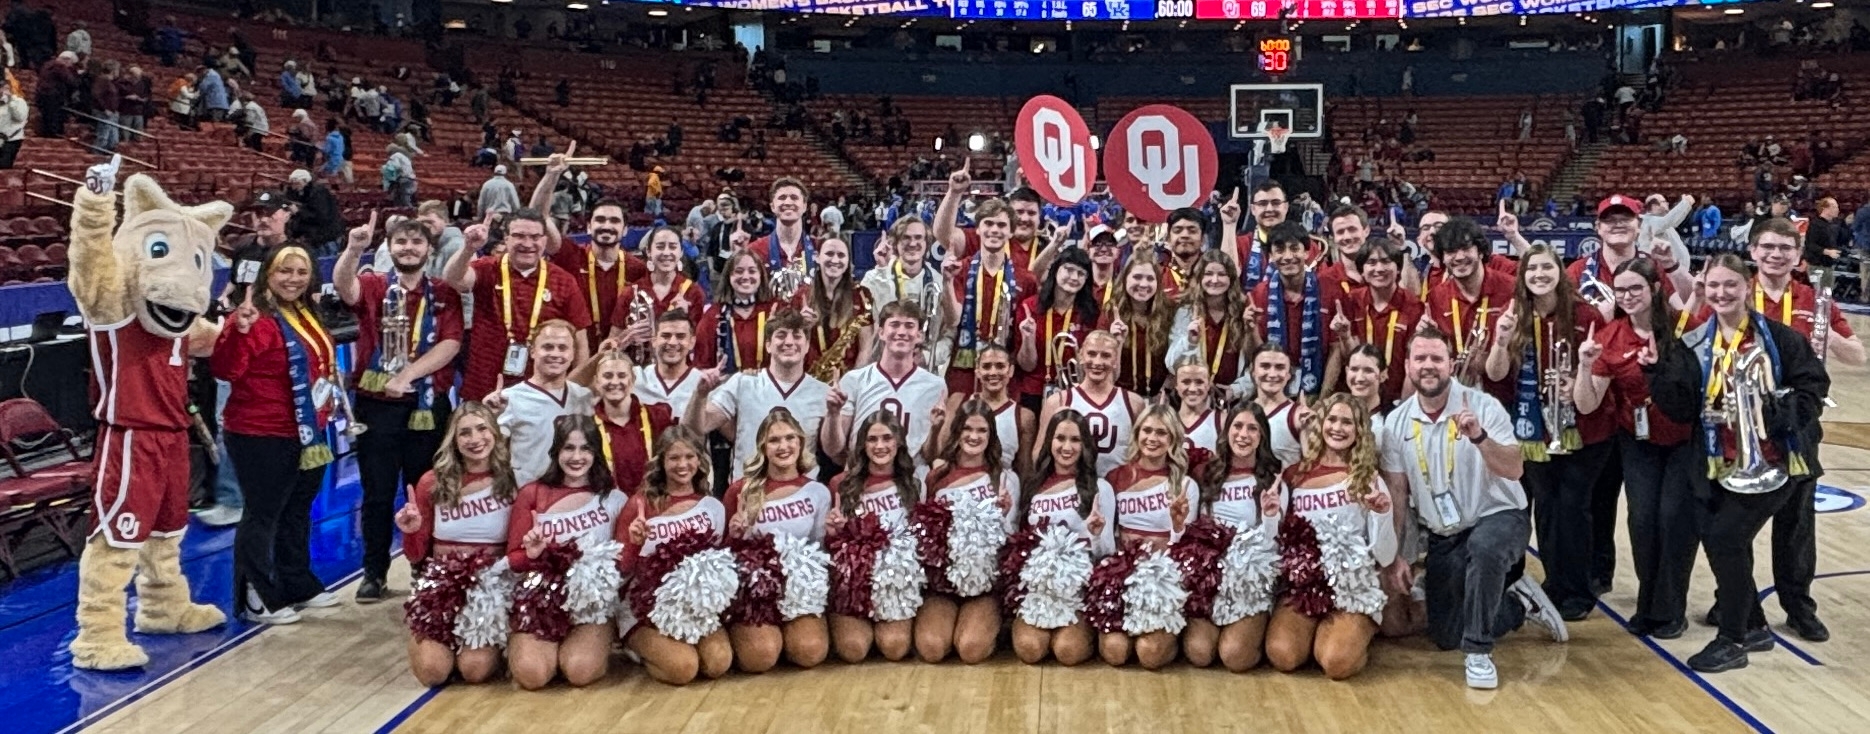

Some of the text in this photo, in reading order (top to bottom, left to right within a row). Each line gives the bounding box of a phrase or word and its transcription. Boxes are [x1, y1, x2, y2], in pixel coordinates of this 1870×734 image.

[800, 1, 928, 15] SKETBALL
[1082, 2, 1098, 17] 65
[1158, 0, 1194, 17] 60:00
[1251, 1, 1267, 17] 69
[1413, 0, 1453, 13] SEC
[1472, 2, 1514, 16] SEC
[1265, 51, 1287, 71] 30
[1033, 107, 1087, 203] OU
[1127, 115, 1200, 210] OU
[756, 497, 815, 524] OONERS
[1118, 490, 1172, 515] OONERS
[1293, 489, 1350, 513] OONER
[116, 512, 140, 540] OU
[539, 507, 610, 538] OONERS
